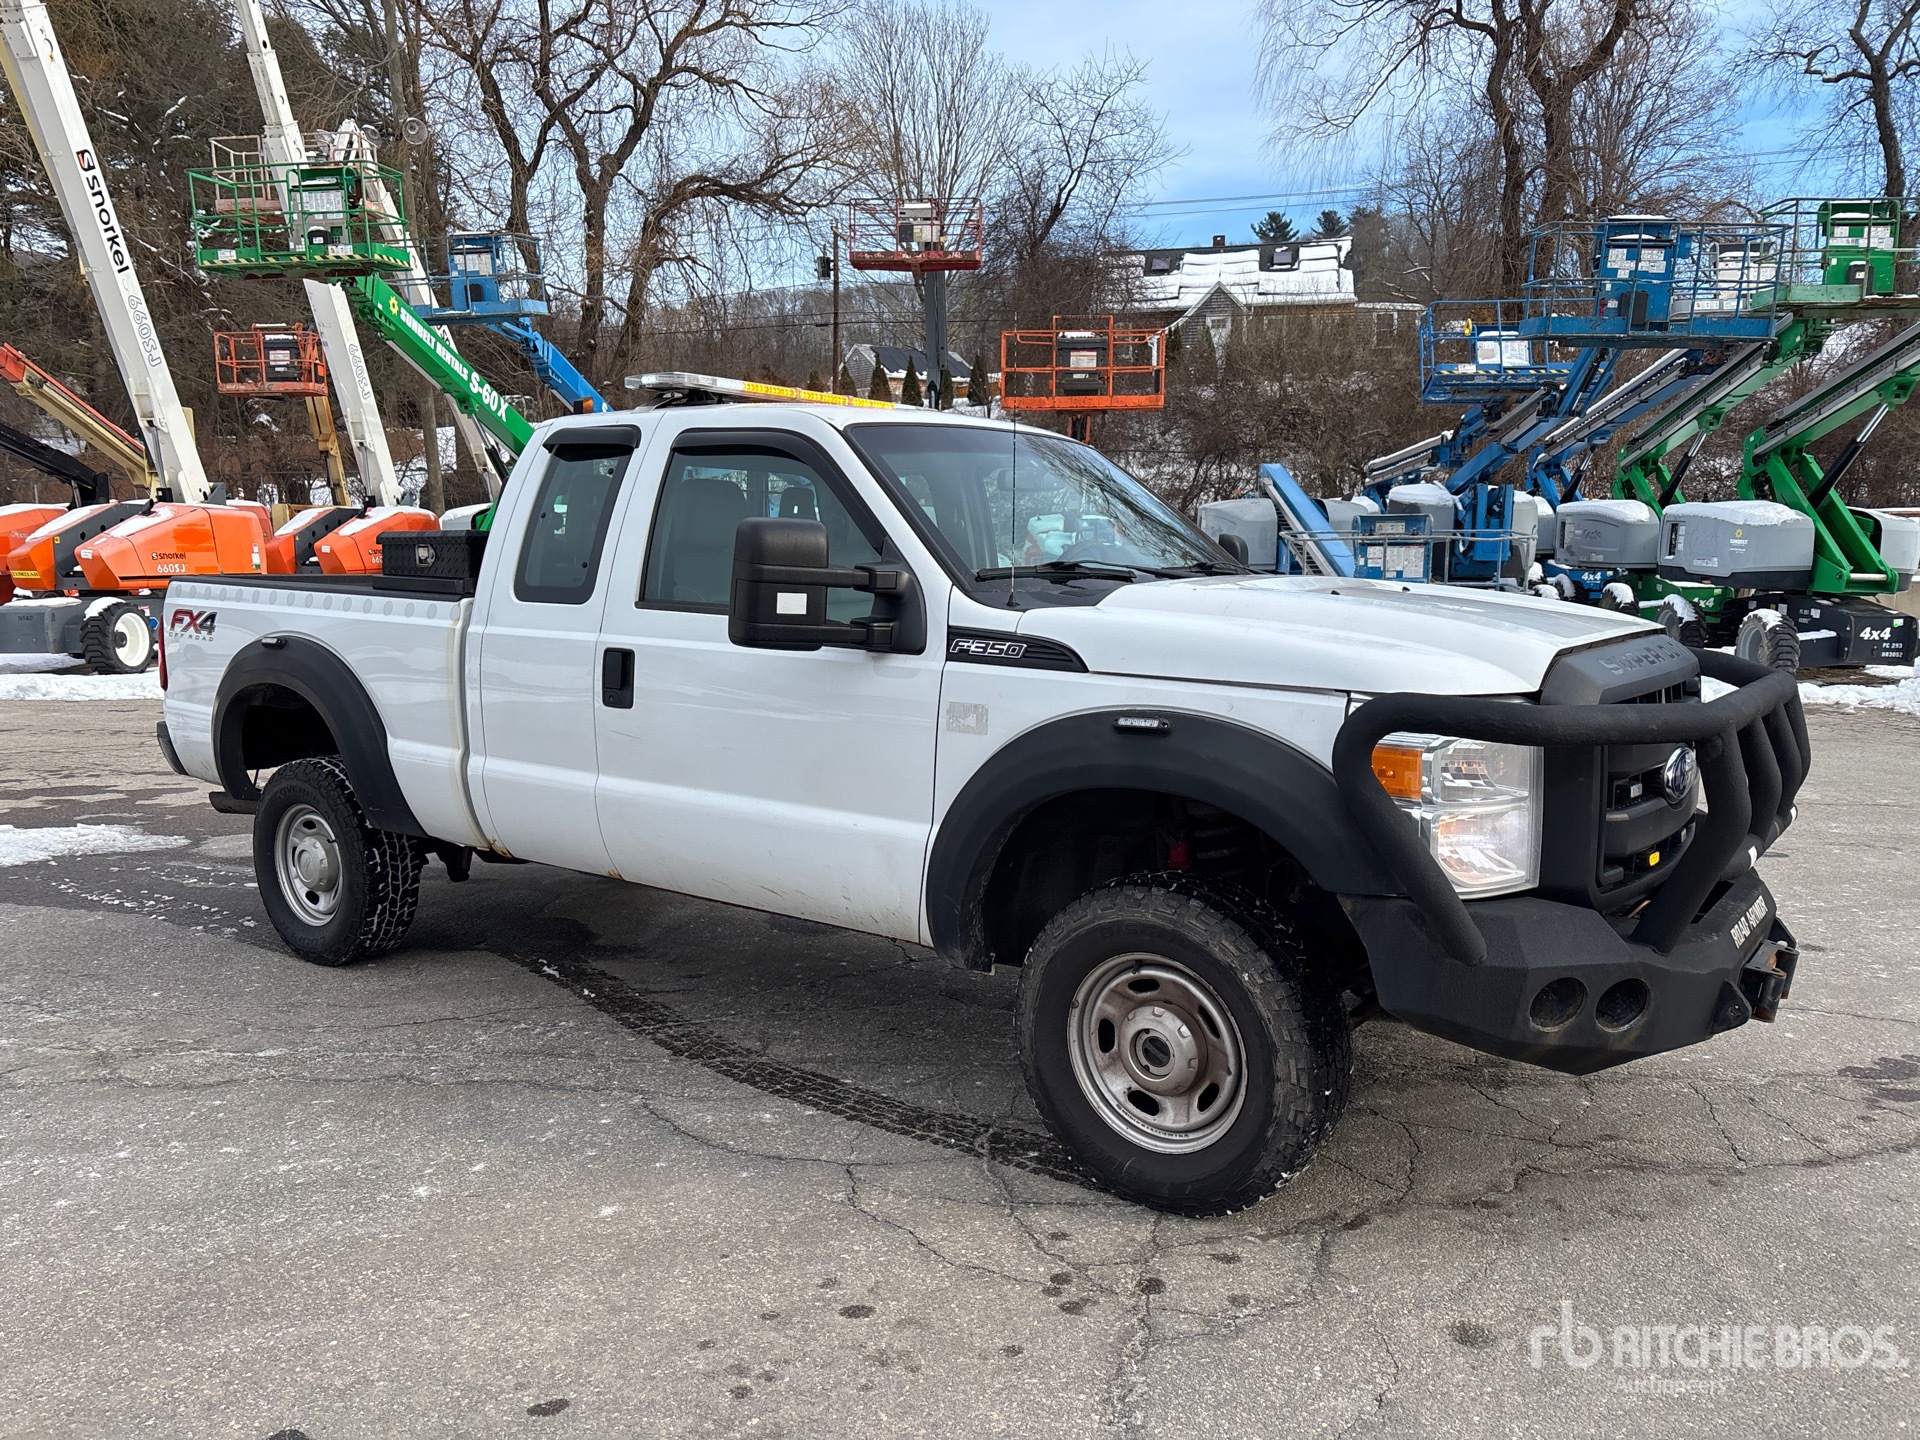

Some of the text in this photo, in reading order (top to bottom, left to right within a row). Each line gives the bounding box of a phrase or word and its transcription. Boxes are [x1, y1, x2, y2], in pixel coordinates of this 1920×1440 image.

[86, 176, 130, 274] snorkel
[128, 294, 163, 368] 660SJ
[400, 306, 436, 351] SUNBELT
[436, 341, 469, 381] RENTALS
[157, 563, 186, 573] 660SJ
[158, 552, 187, 560] snorkel
[1581, 571, 1602, 581] 4x4
[170, 608, 218, 635] FX4
[1859, 626, 1892, 640] 4x4
[1730, 895, 1769, 949] ROAD ARMOR
